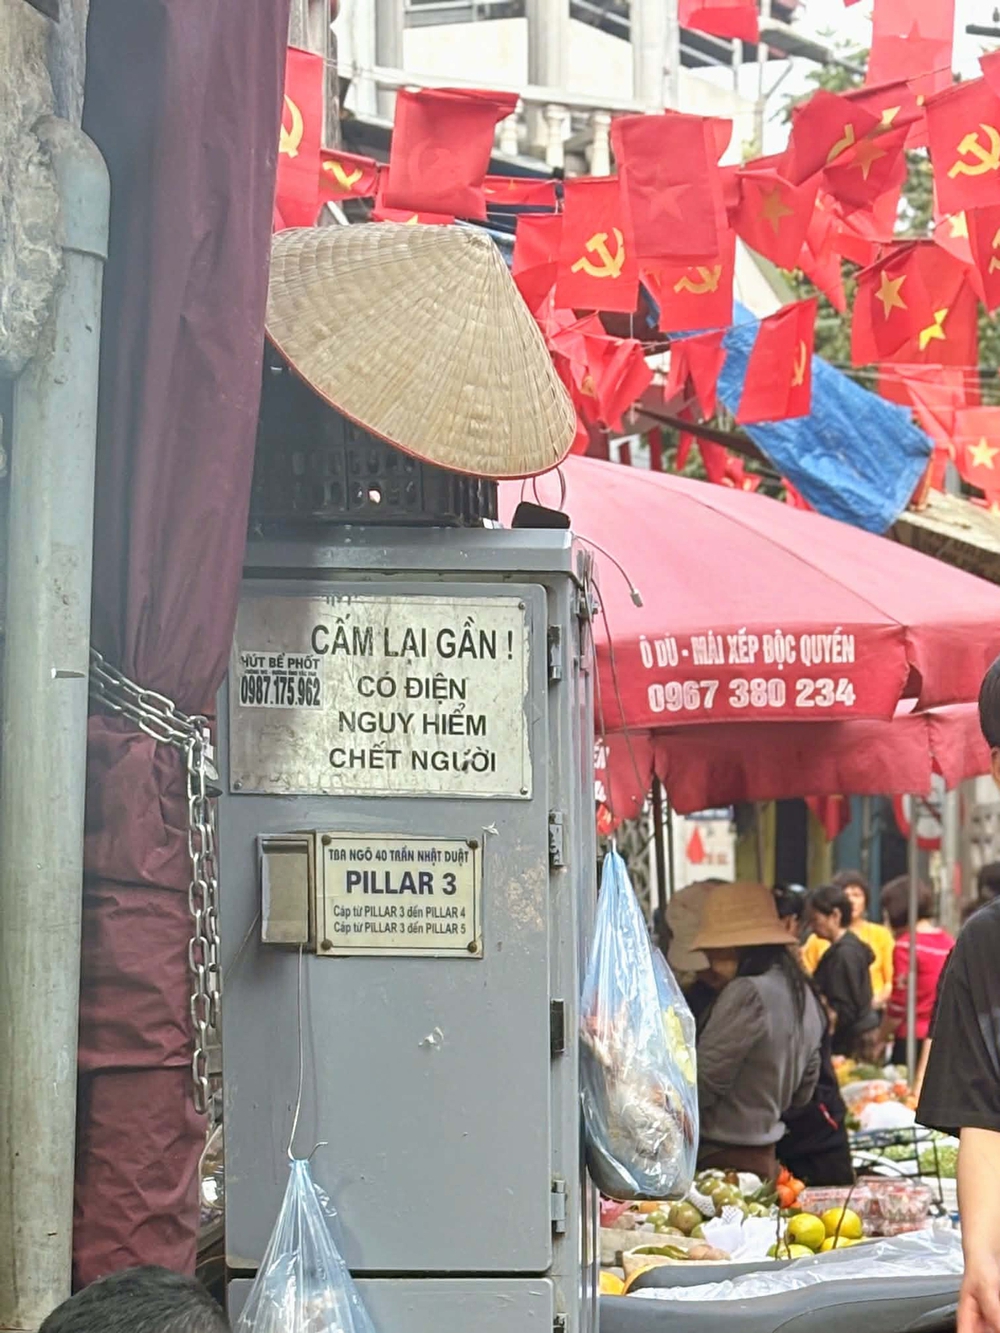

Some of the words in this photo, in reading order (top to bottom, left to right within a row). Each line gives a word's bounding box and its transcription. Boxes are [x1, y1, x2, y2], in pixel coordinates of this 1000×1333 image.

[311, 613, 374, 656] CẤM
[384, 627, 427, 666] LẠI
[436, 616, 496, 659] GẦN
[727, 626, 759, 665] XẾP
[762, 629, 796, 670] ĐỘC
[287, 654, 321, 669] PHỐT
[240, 675, 321, 706] 0987.175.962
[357, 671, 397, 698] CÓ
[404, 672, 467, 704] ĐIỆN
[647, 680, 719, 712] 0967
[728, 678, 787, 707] 380
[795, 678, 856, 707] 234
[338, 711, 414, 734] NGUY
[422, 703, 487, 736] HIỂM
[329, 741, 402, 769] CHẾT
[411, 747, 497, 773] NGƯỜI
[375, 849, 388, 861] 40
[346, 870, 434, 895] PILLAR
[442, 872, 457, 896] 3
[364, 905, 398, 918] PILLAR
[399, 905, 405, 918] 3
[425, 906, 459, 919] PILLAR
[459, 906, 466, 919] 4
[364, 921, 398, 934] PILLAR
[399, 922, 405, 934] 3
[425, 922, 459, 935] PILLAR
[460, 923, 467, 935] 5
